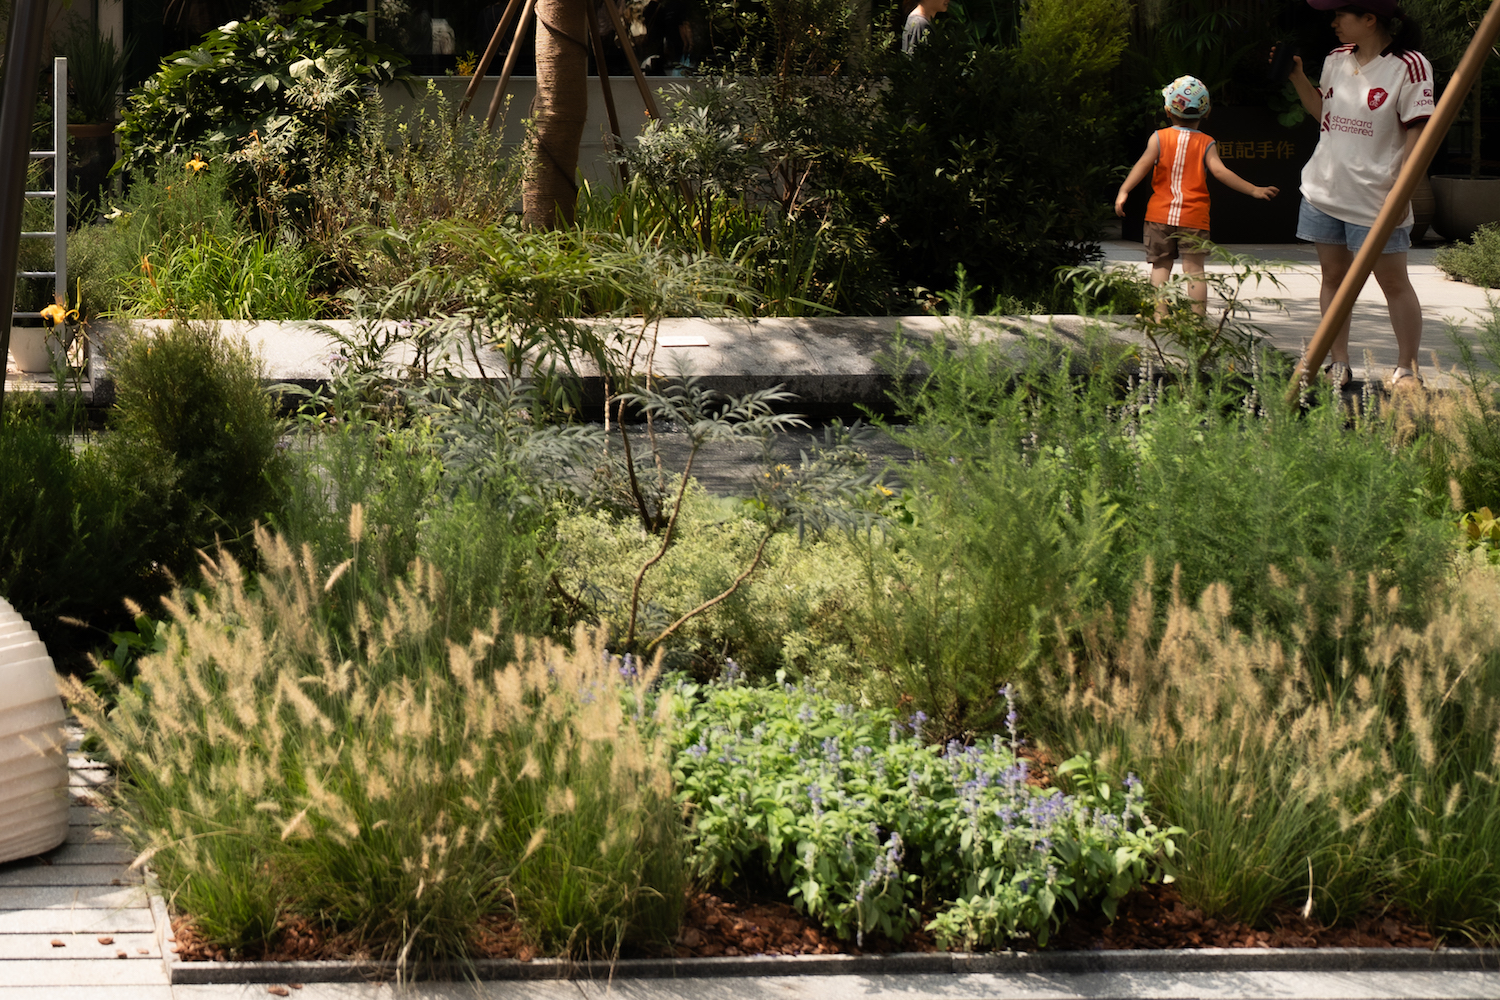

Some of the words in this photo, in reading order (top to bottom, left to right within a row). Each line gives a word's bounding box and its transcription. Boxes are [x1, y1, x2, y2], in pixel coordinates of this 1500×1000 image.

[1330, 121, 1374, 138] chartered
[1332, 115, 1373, 129] standard
[1216, 140, 1296, 160] 恒記手作
